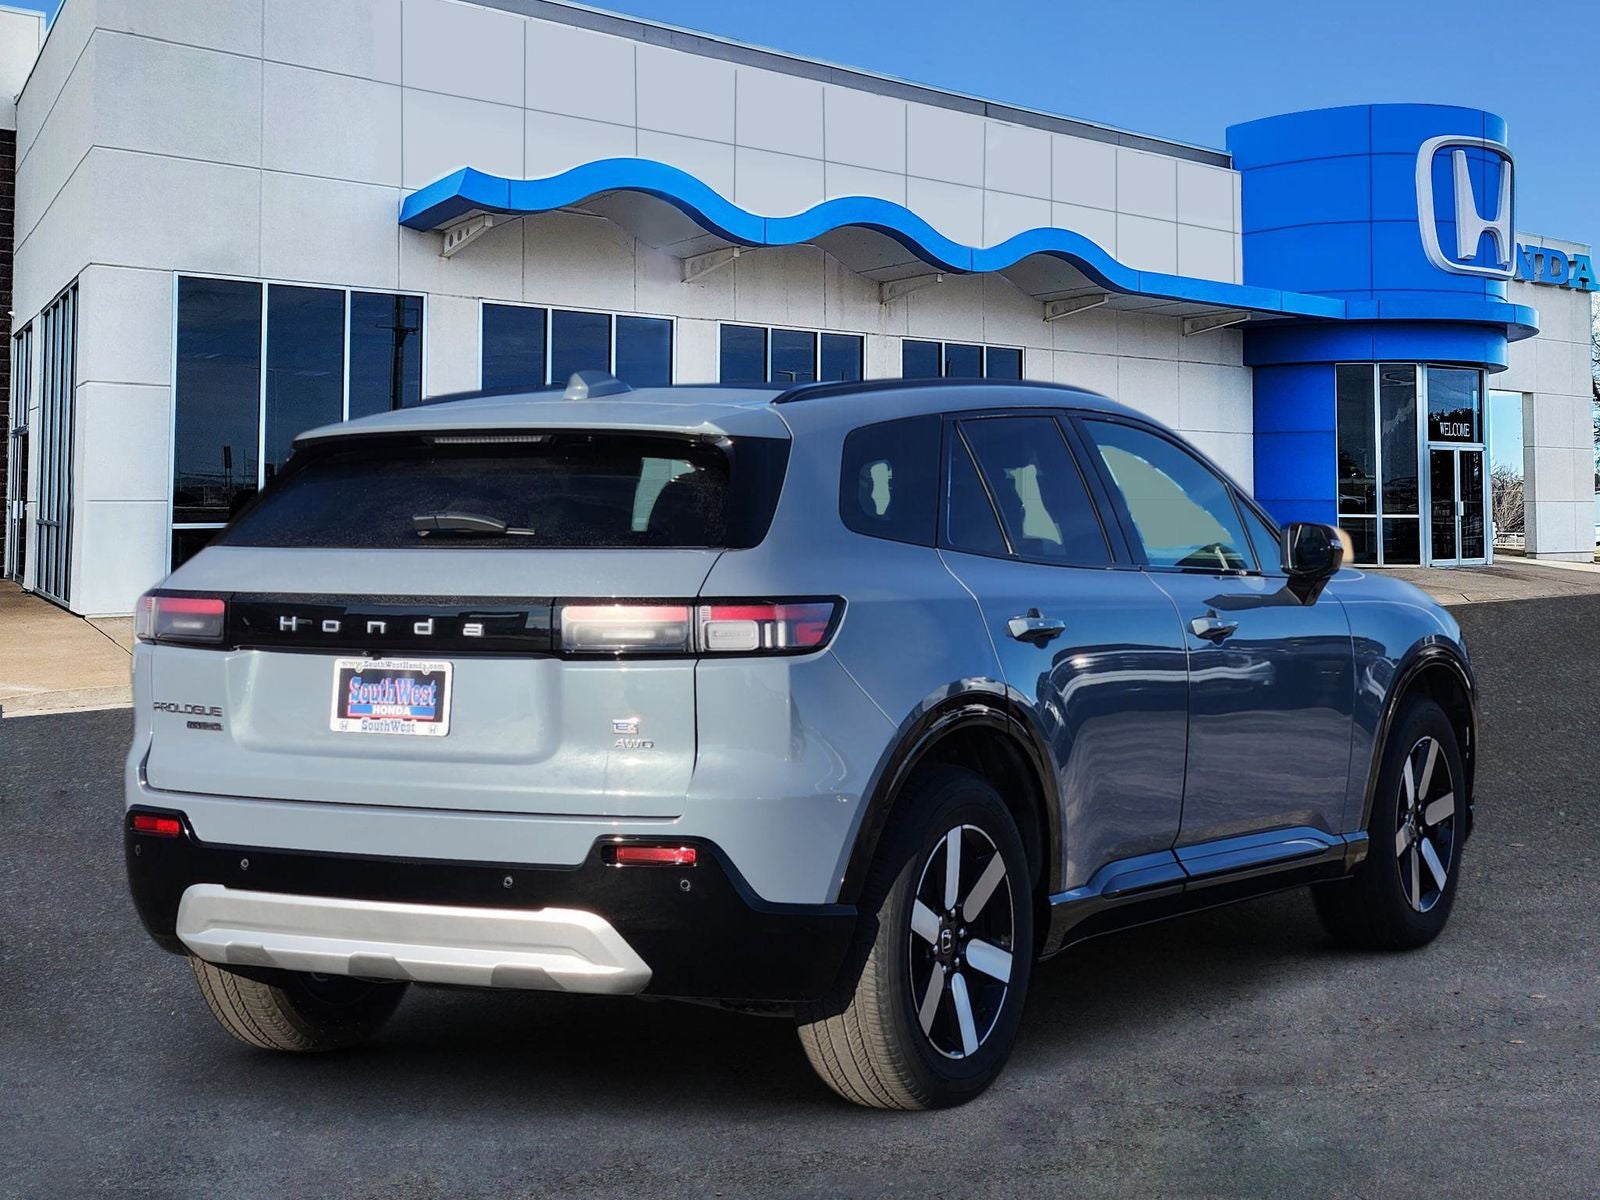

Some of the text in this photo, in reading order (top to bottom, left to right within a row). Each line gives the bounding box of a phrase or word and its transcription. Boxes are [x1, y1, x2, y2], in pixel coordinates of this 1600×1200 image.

[1439, 422, 1471, 437] WELCOME
[280, 616, 484, 637] Honda
[153, 702, 223, 717] PROLOGUE
[372, 705, 411, 715] HONDA
[361, 720, 416, 733] SouthWest
